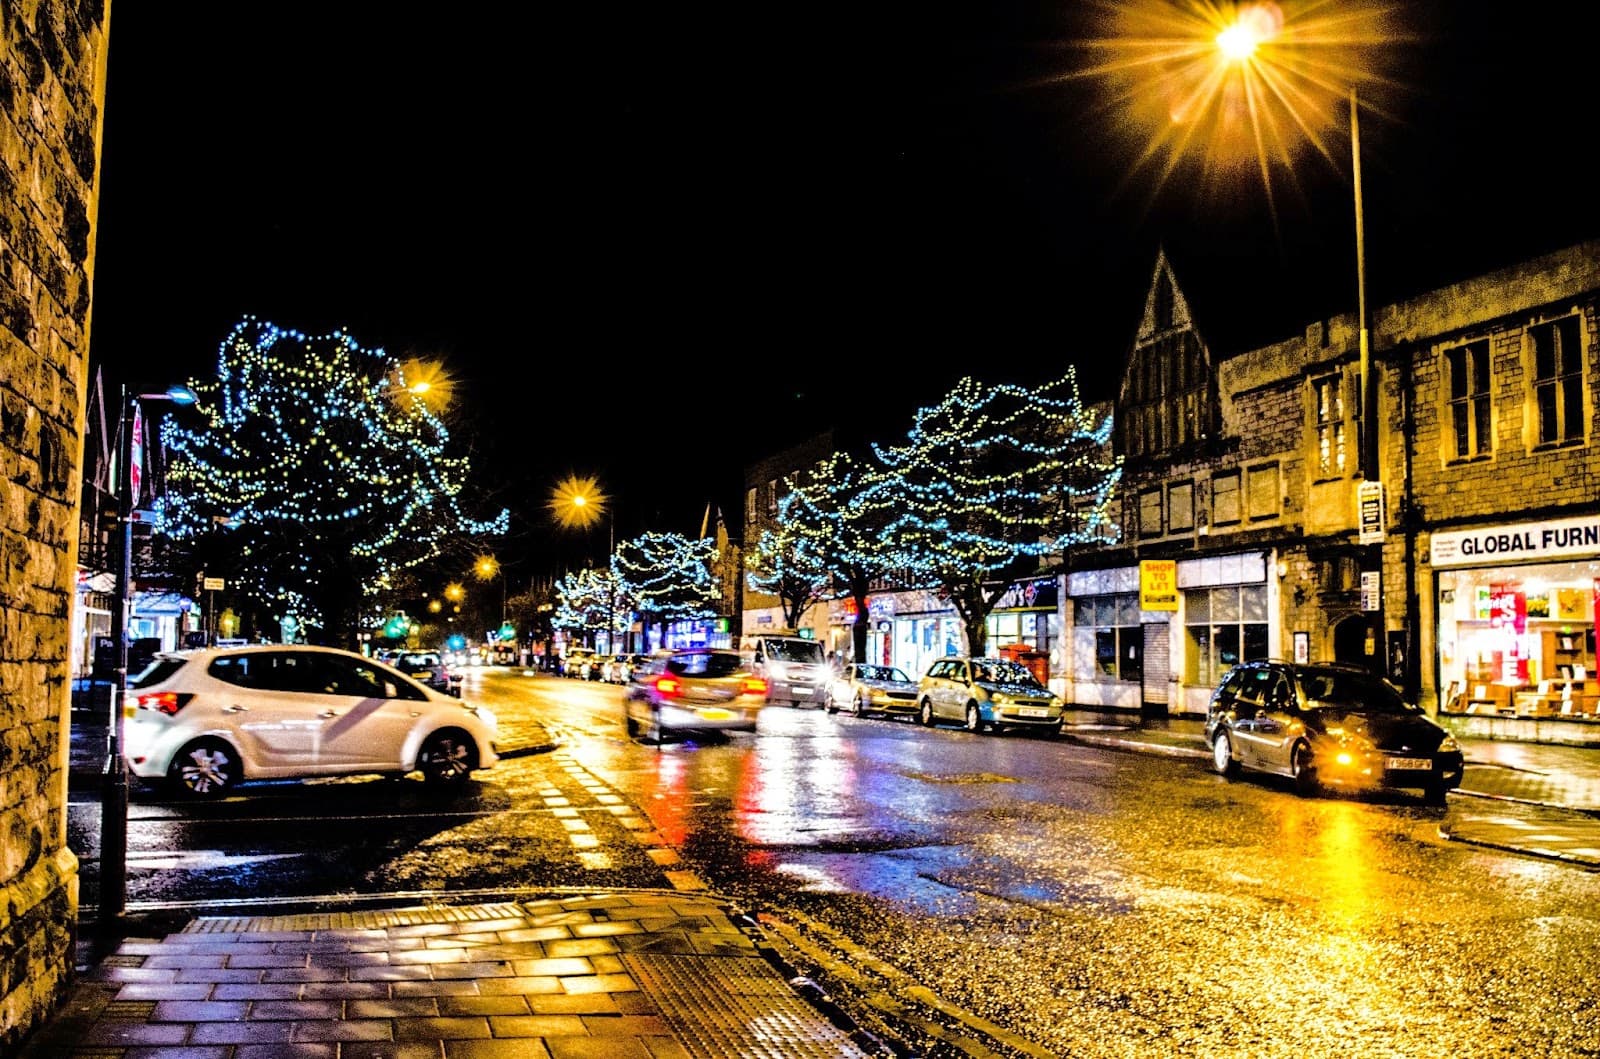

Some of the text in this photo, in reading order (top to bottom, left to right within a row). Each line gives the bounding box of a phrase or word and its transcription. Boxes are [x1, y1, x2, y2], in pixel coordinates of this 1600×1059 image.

[1461, 532, 1536, 556] GLOBAL
[1145, 563, 1174, 572] SHOP
[1152, 573, 1167, 581] TO
[1149, 582, 1169, 591] LET
